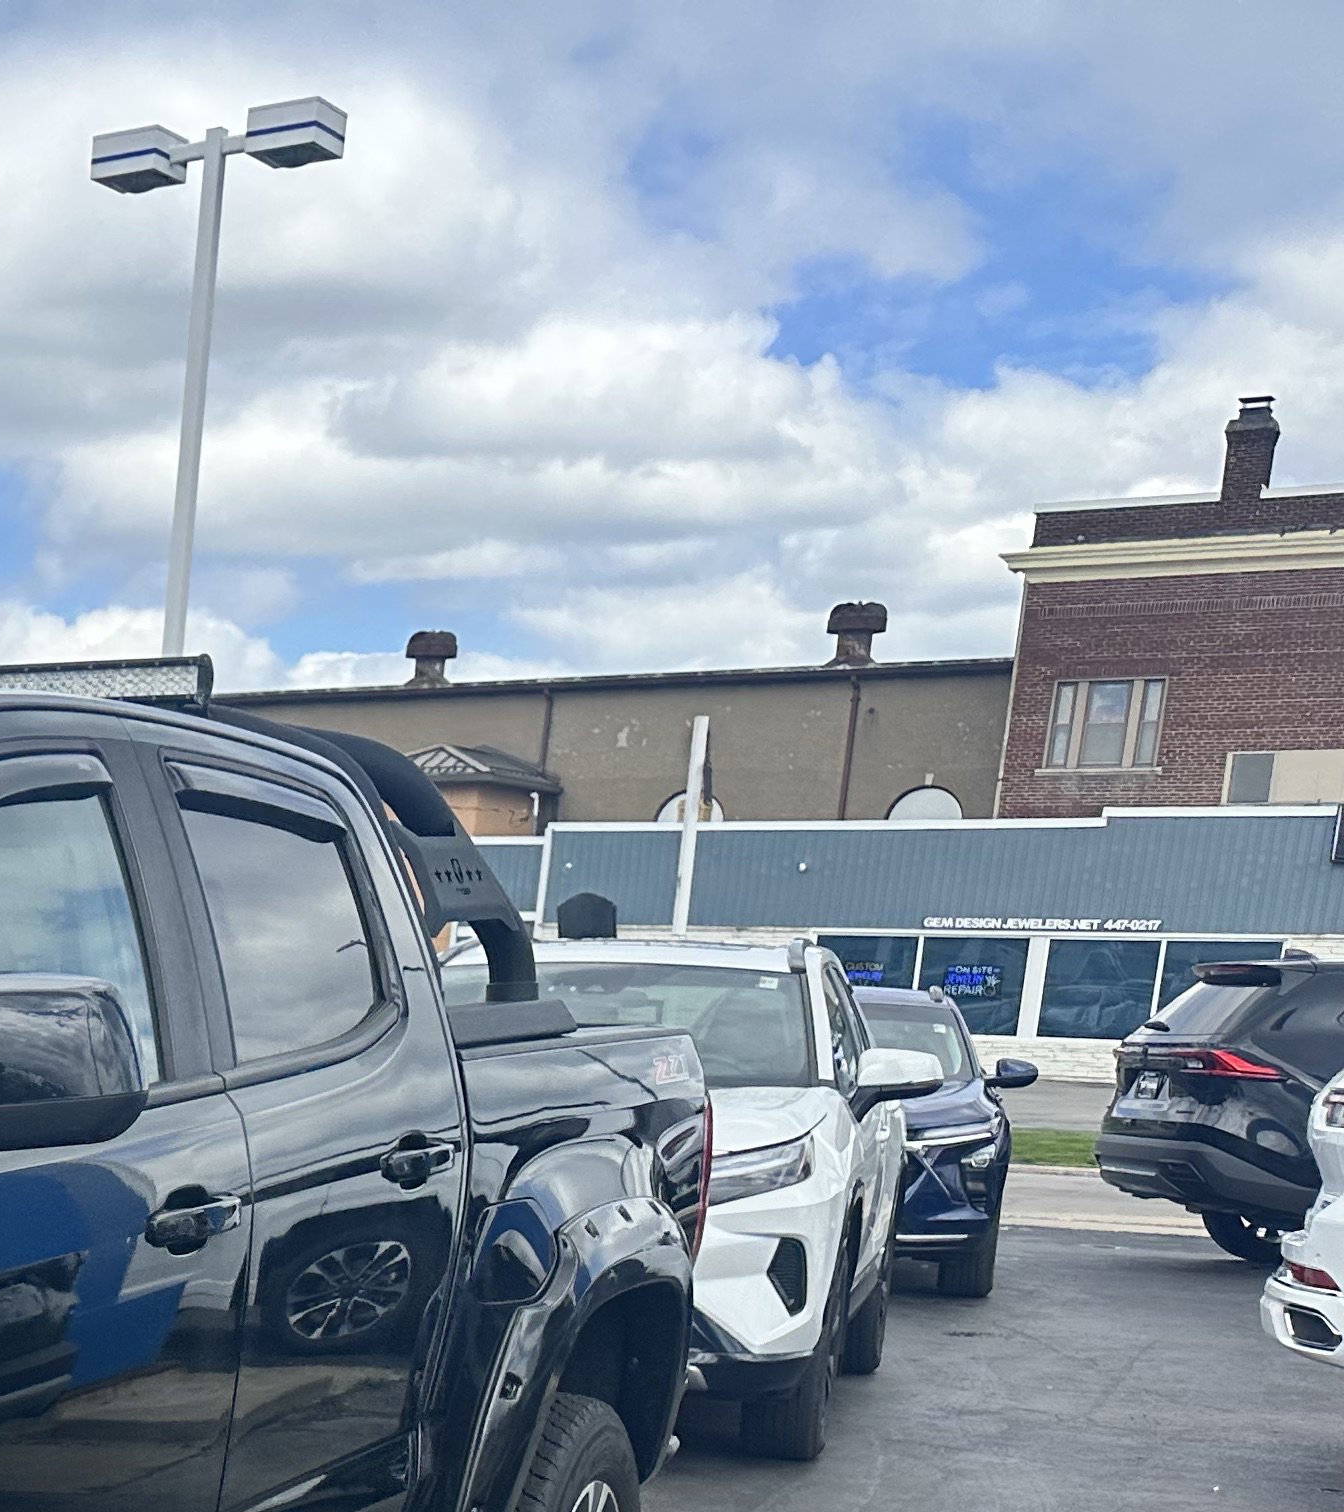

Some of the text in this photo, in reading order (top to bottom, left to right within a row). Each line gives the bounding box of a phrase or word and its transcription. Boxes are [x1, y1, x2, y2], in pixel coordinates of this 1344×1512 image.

[923, 917, 1162, 931] GEM DESIGN JEWELERS.NET 447-0217
[943, 984, 983, 996] REPAIR
